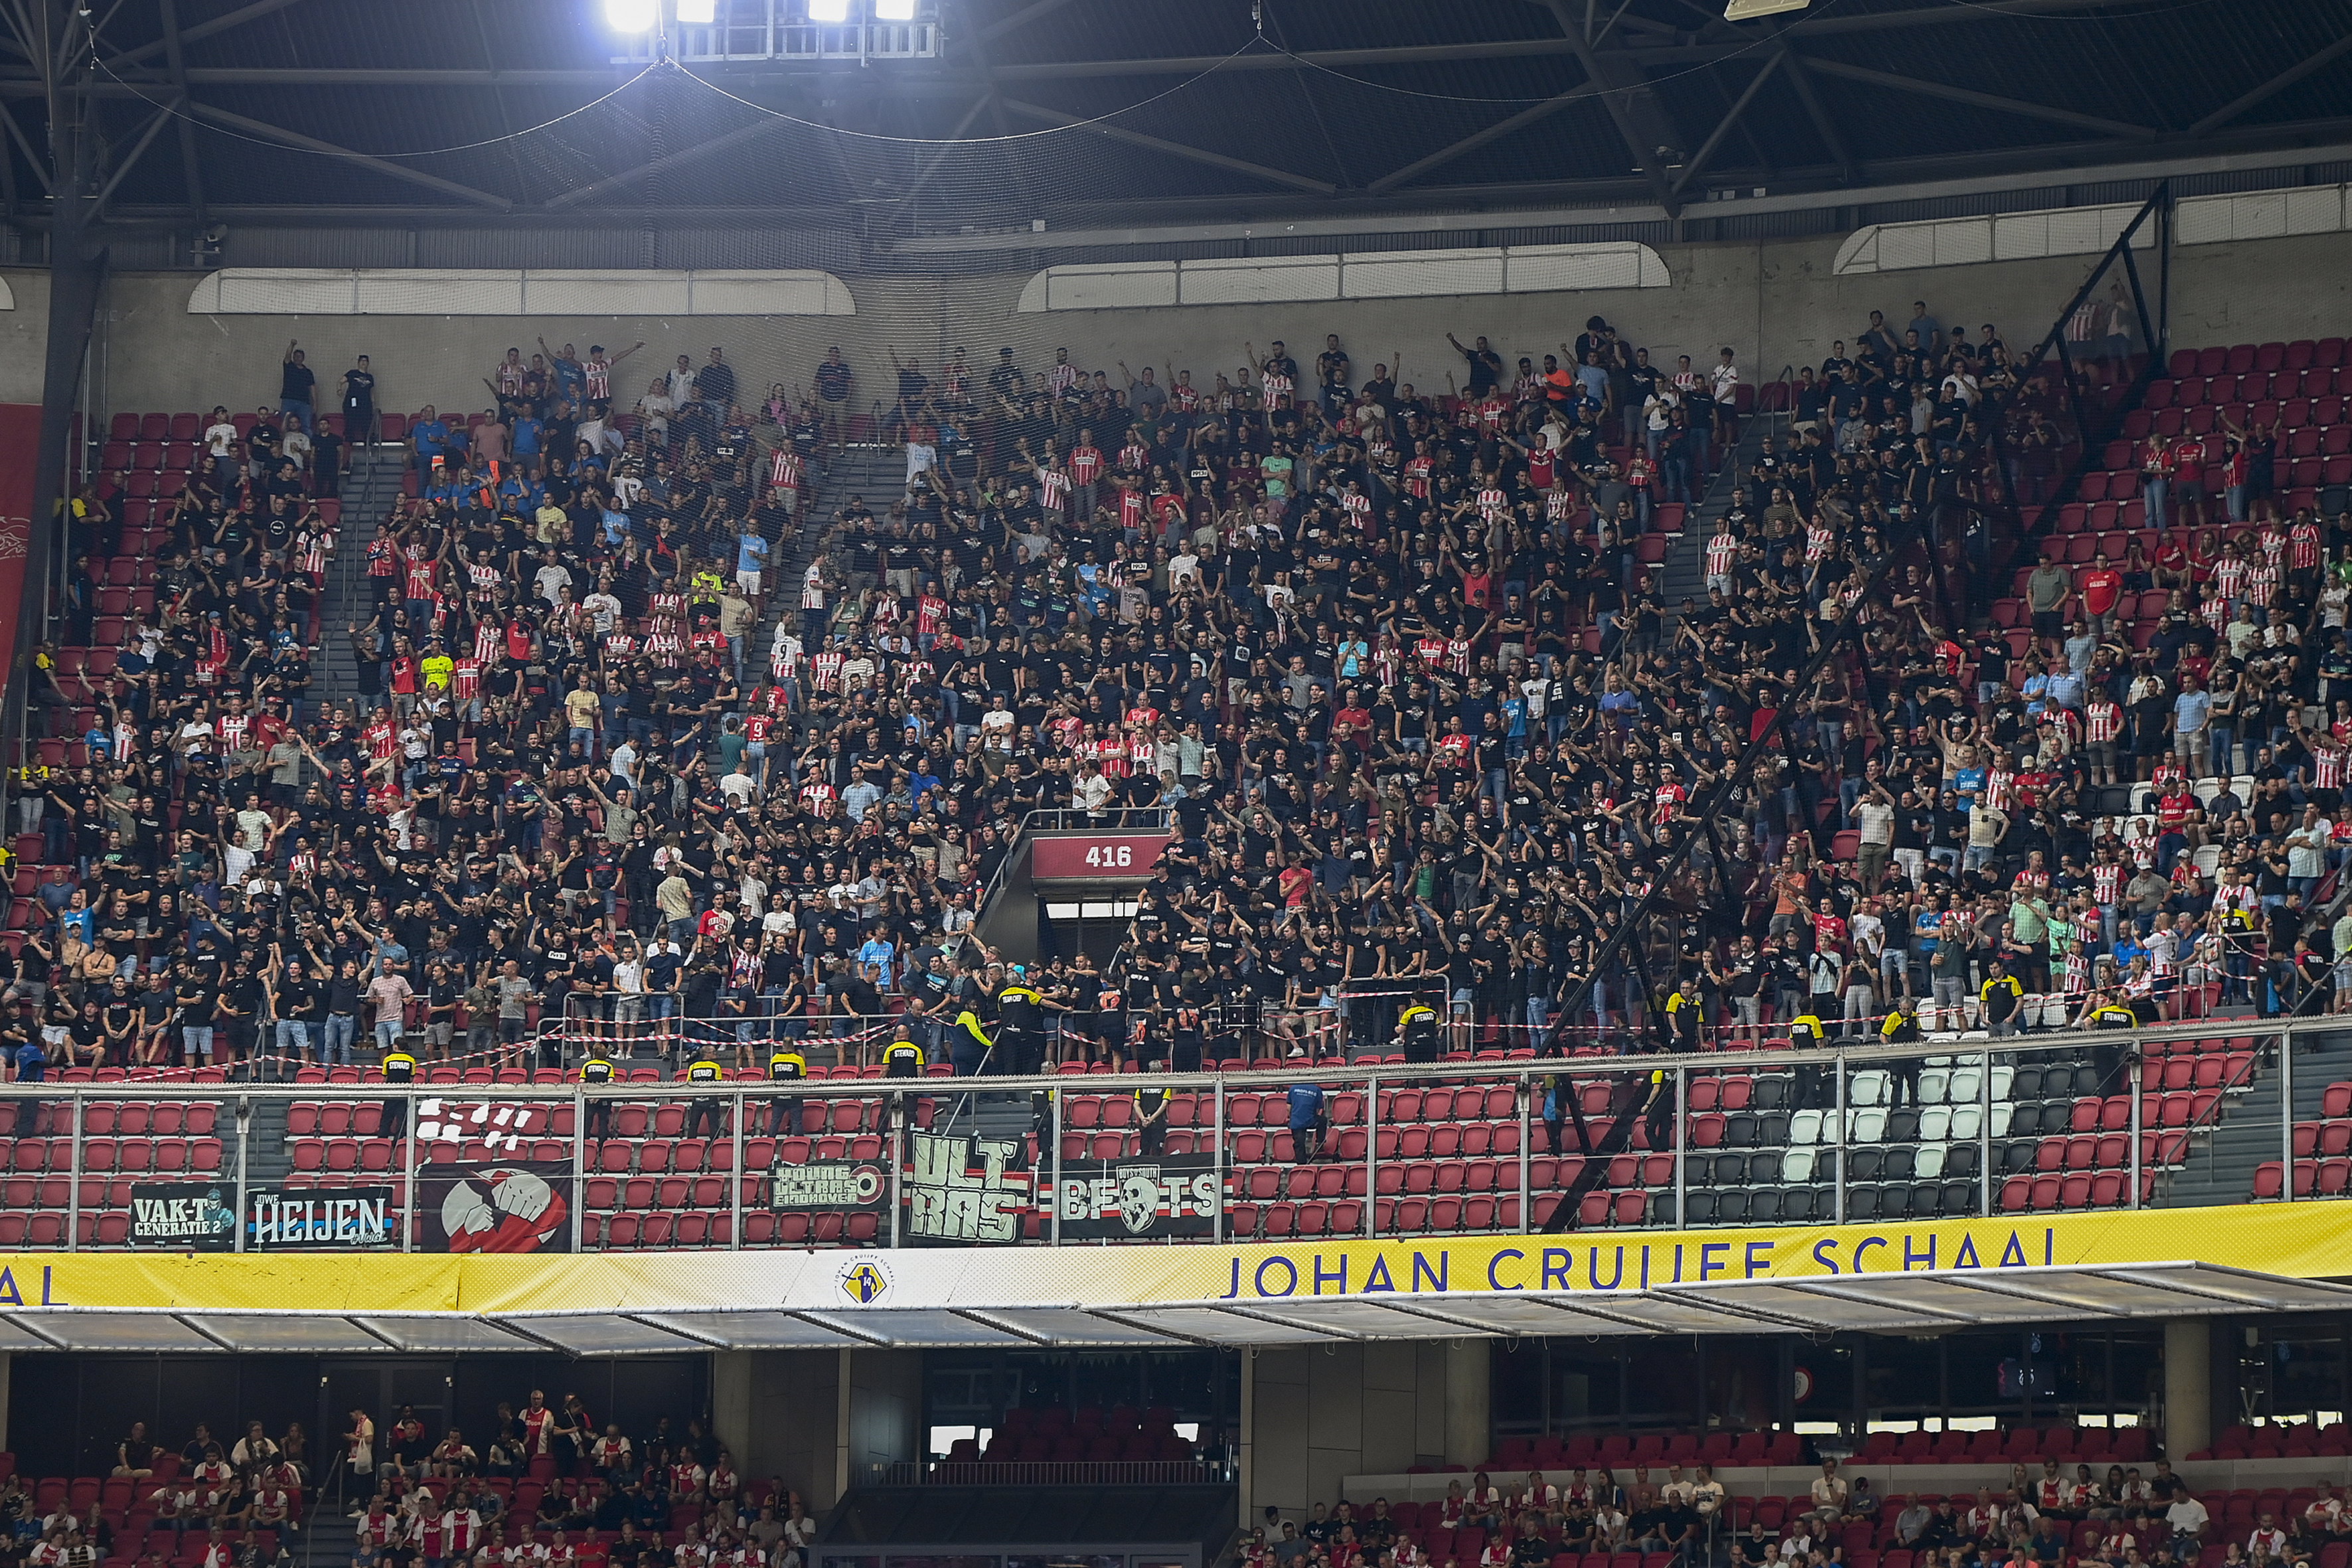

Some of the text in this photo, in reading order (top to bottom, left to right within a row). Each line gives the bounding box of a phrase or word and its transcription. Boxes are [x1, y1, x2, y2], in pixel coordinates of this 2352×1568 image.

[780, 645, 787, 657] 9
[754, 722, 763, 738] 9
[1085, 846, 1132, 867] 416
[1415, 1013, 1434, 1022] STEWARD
[2104, 1012, 2127, 1022] STEWARD
[894, 1049, 915, 1058] STEWARD
[389, 1061, 410, 1071] STEWARD
[588, 1065, 607, 1073] STEWARD
[775, 1063, 793, 1073] STEWARD
[693, 1069, 712, 1079] STEWARD
[913, 1133, 1018, 1189] ULT
[777, 1166, 850, 1182] YOUNG
[1119, 1168, 1133, 1179] BOYS
[1138, 1167, 1157, 1178] SOUTH
[774, 1180, 858, 1196] ULTRAS
[255, 1194, 279, 1206] JOWE
[774, 1194, 858, 1206] EINDHOVEN
[134, 1198, 208, 1223] VAK-T
[908, 1185, 1017, 1243] RAS
[254, 1198, 386, 1244] HEIJEN
[135, 1219, 220, 1237] GENERATIE 2
[351, 1231, 387, 1245] #VWGL
[1220, 1251, 1449, 1299] JOHAN
[863, 1277, 872, 1287] 14
